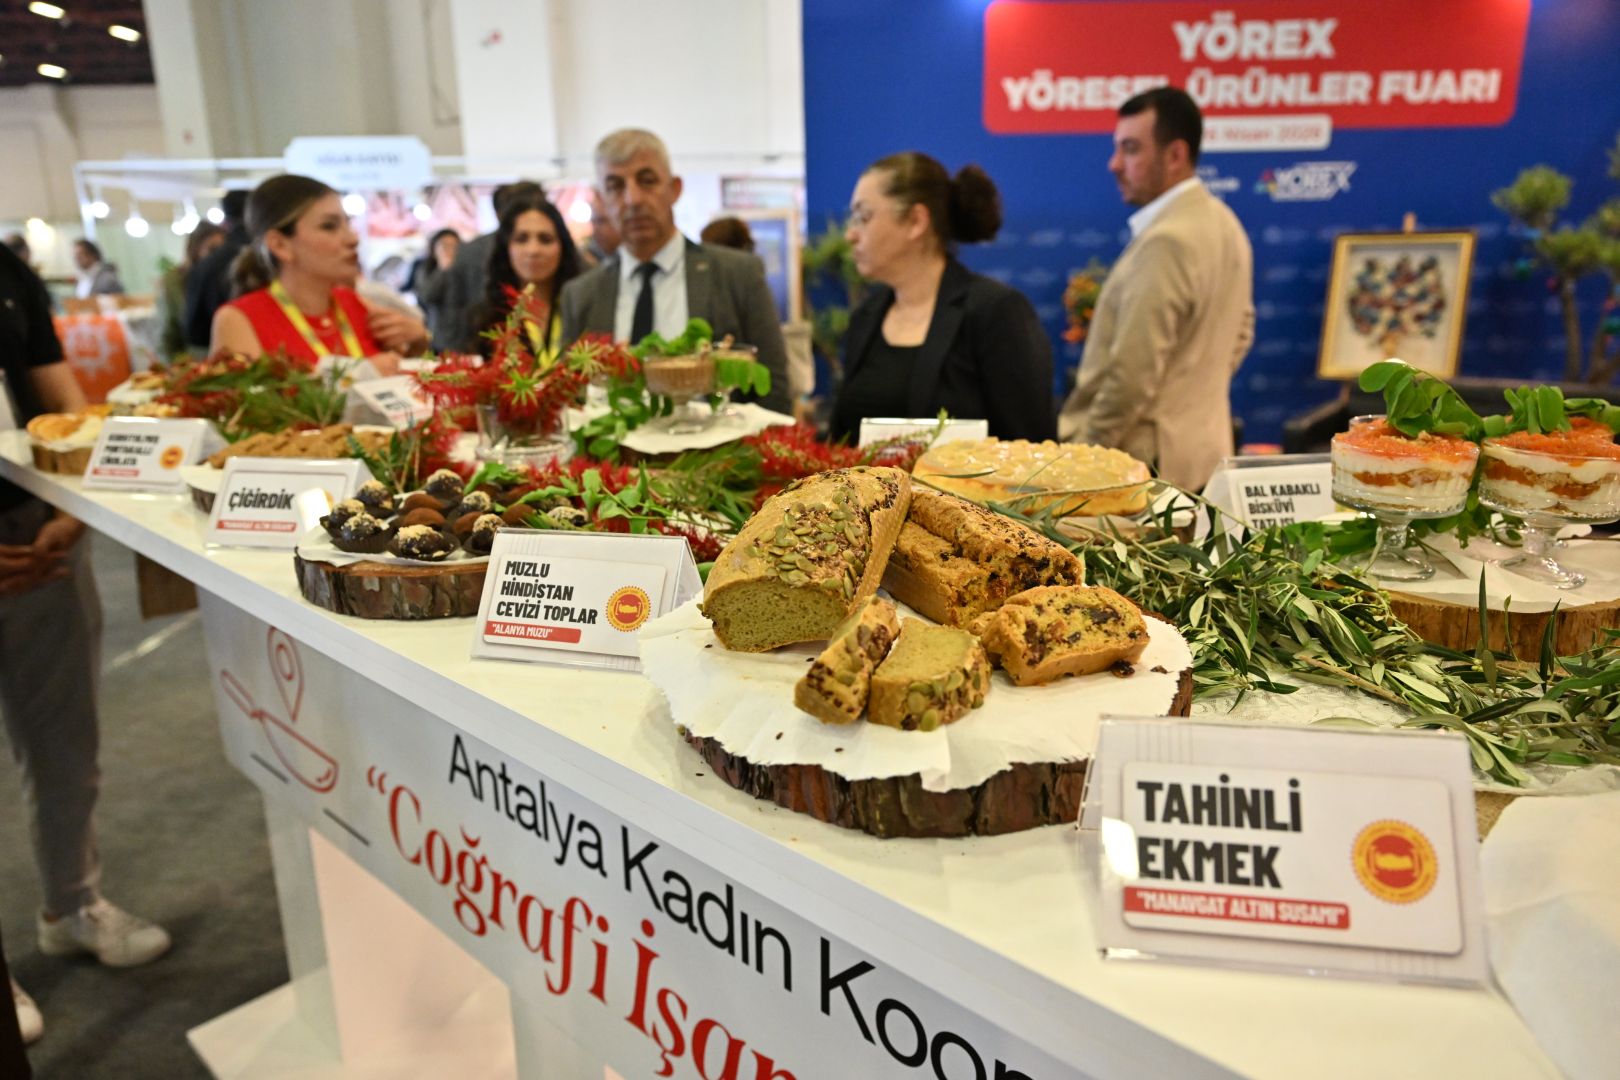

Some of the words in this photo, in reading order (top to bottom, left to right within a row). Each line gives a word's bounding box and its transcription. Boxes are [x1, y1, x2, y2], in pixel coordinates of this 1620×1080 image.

[1172, 12, 1337, 61] YÖREX
[1186, 67, 1372, 108] ÜRÜNLER
[1378, 70, 1501, 104] FUARI
[229, 487, 295, 512] ÇİĞİRDİK
[1245, 485, 1268, 498] BAL
[1270, 483, 1321, 497] KABAKLI
[1248, 498, 1296, 514] BİSKÜVİ
[504, 560, 550, 578] MUZLU
[500, 577, 574, 601] HİNDİSTAN
[496, 599, 541, 619] CEVİZİ
[543, 604, 598, 625] TOPLAR
[492, 623, 525, 636] "ALANYA
[526, 626, 553, 638] MUZU"
[1137, 774, 1303, 833] TAHİNLİ
[1138, 836, 1282, 889] EKMEK
[367, 765, 609, 1003] “Coğrafi
[448, 733, 608, 878] Antalya
[621, 825, 792, 992] Kadın
[820, 936, 1036, 1080] Koo
[1136, 890, 1227, 917] "MANAVGAT
[1228, 897, 1275, 920] ALTIN
[1277, 901, 1346, 925] SUSAMI"
